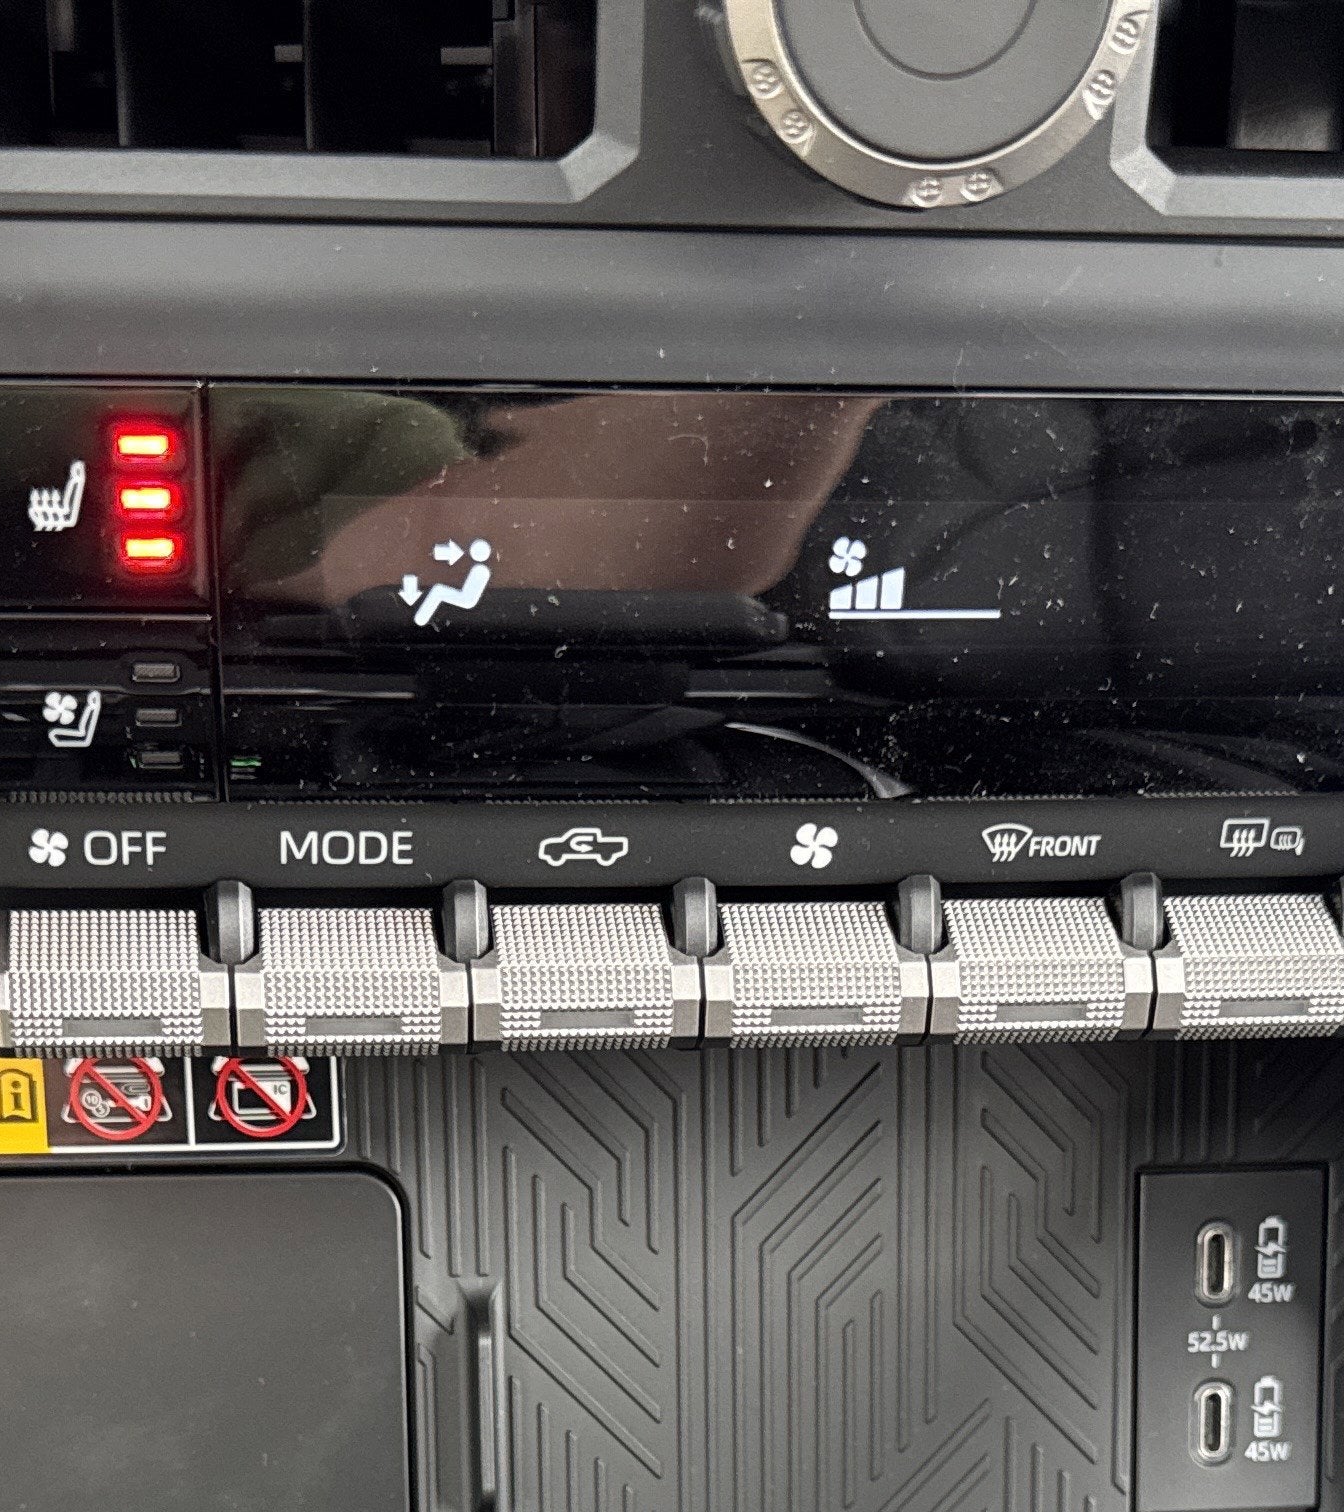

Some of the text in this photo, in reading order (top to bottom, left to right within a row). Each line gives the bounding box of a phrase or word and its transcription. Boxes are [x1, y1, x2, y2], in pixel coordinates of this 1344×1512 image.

[83, 830, 168, 866] OFF
[280, 831, 414, 866] MODE
[1029, 834, 1101, 858] FRONT
[1248, 1282, 1293, 1303] 45W
[1187, 1330, 1248, 1353] 52.5W
[1244, 1441, 1290, 1462] 45W
